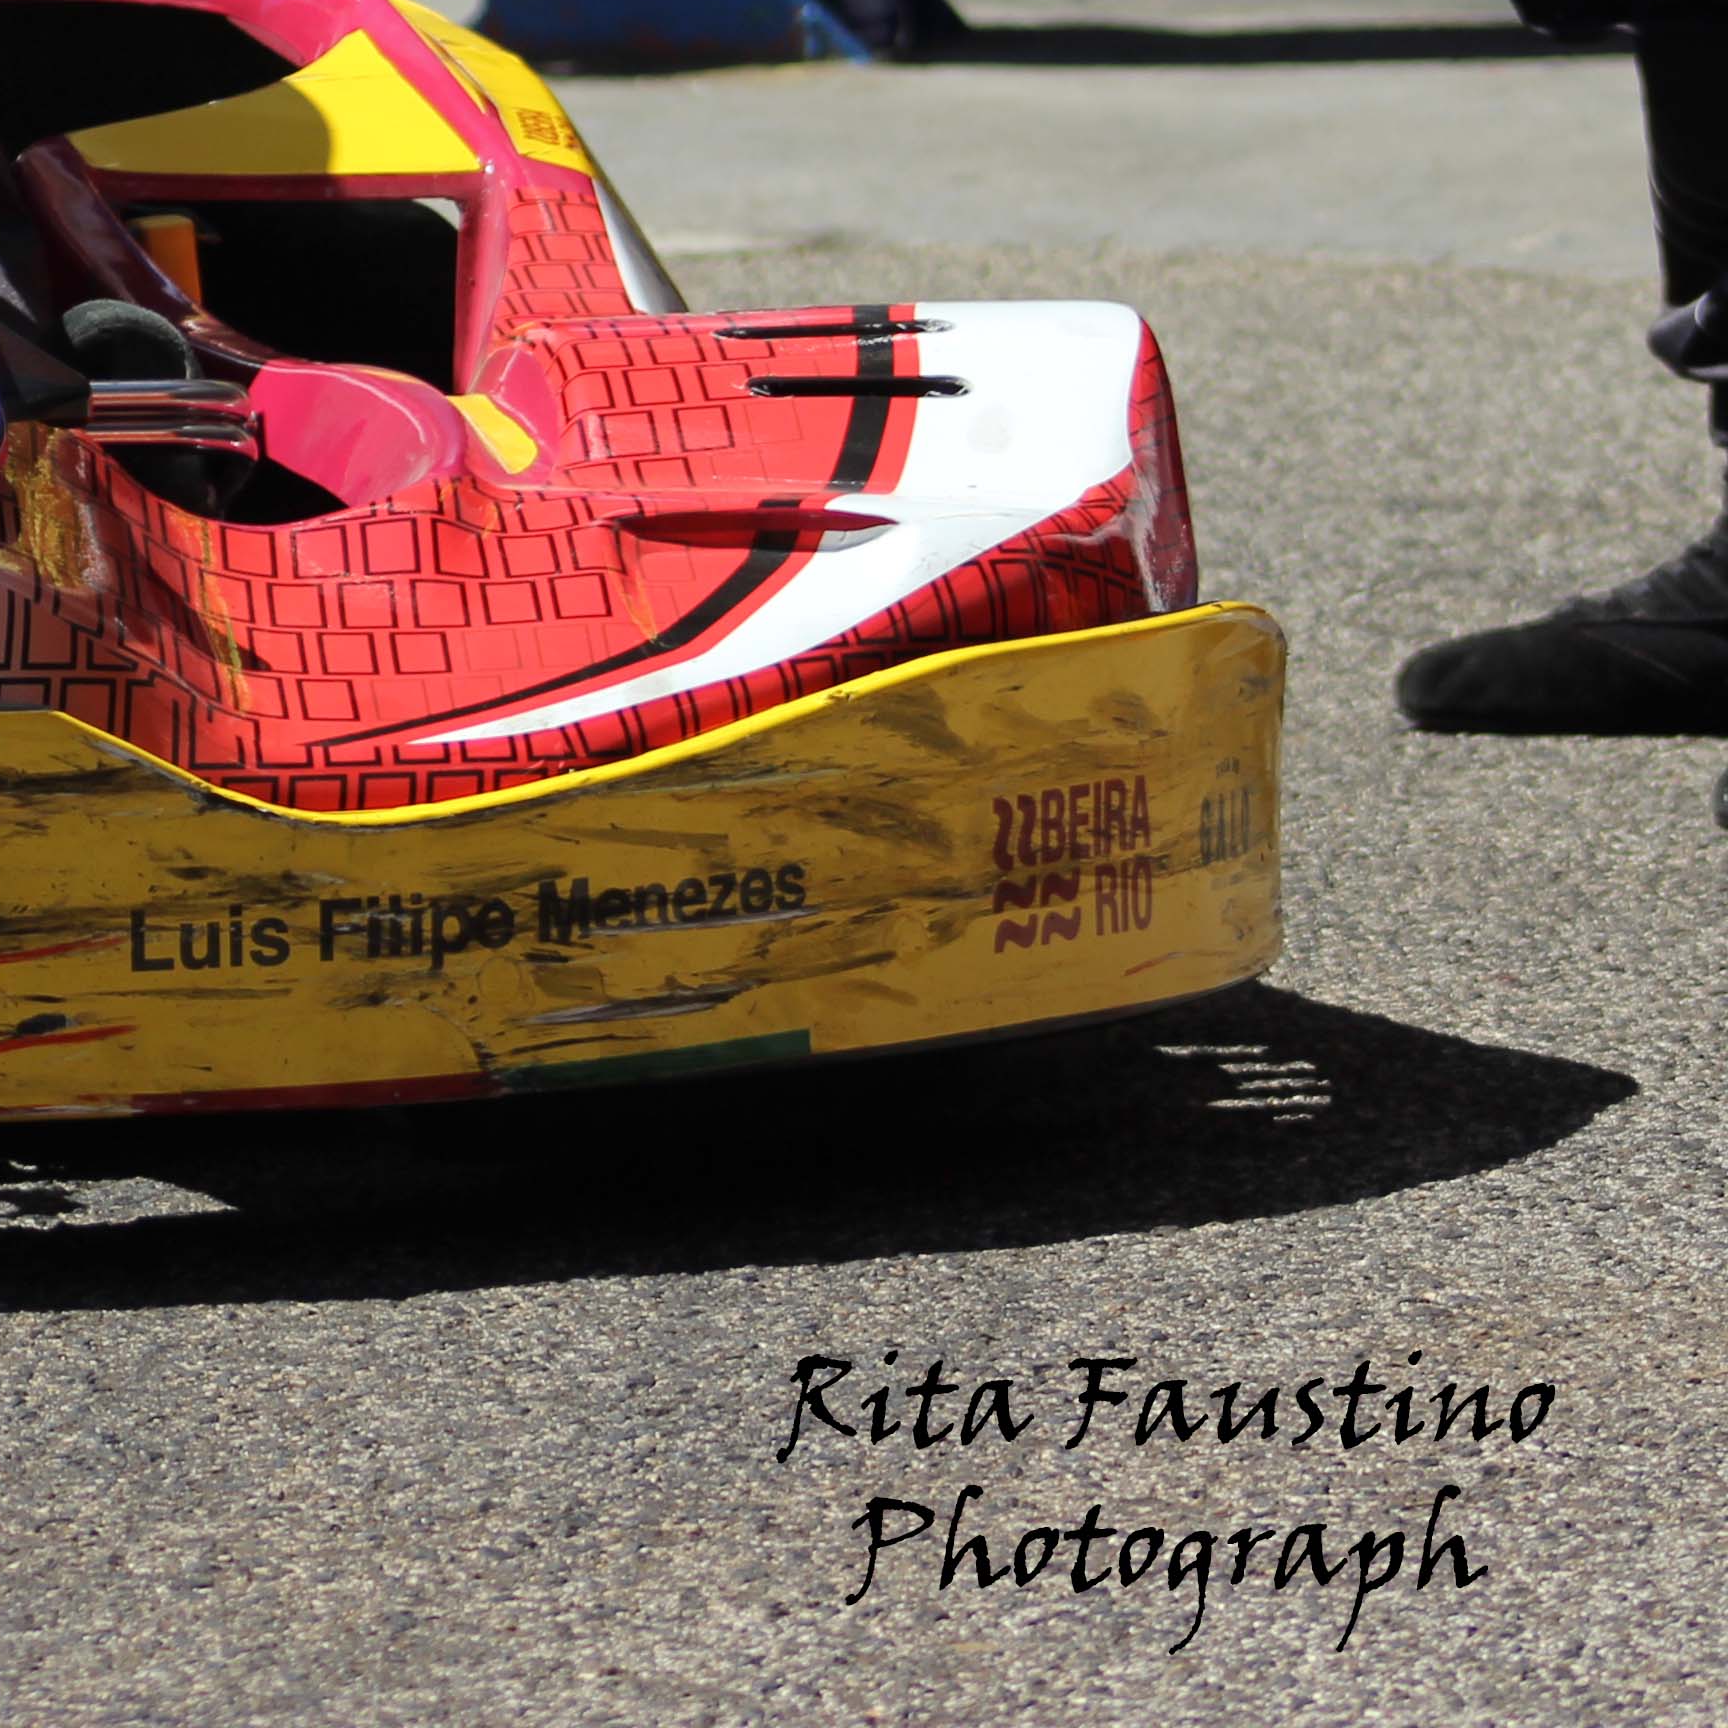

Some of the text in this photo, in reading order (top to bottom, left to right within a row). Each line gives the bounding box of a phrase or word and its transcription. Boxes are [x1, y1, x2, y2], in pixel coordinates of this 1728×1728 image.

[1040, 774, 1153, 865] BEIRA
[129, 903, 291, 973] Luis
[536, 862, 807, 945] Menezes
[1094, 855, 1154, 937] RIO
